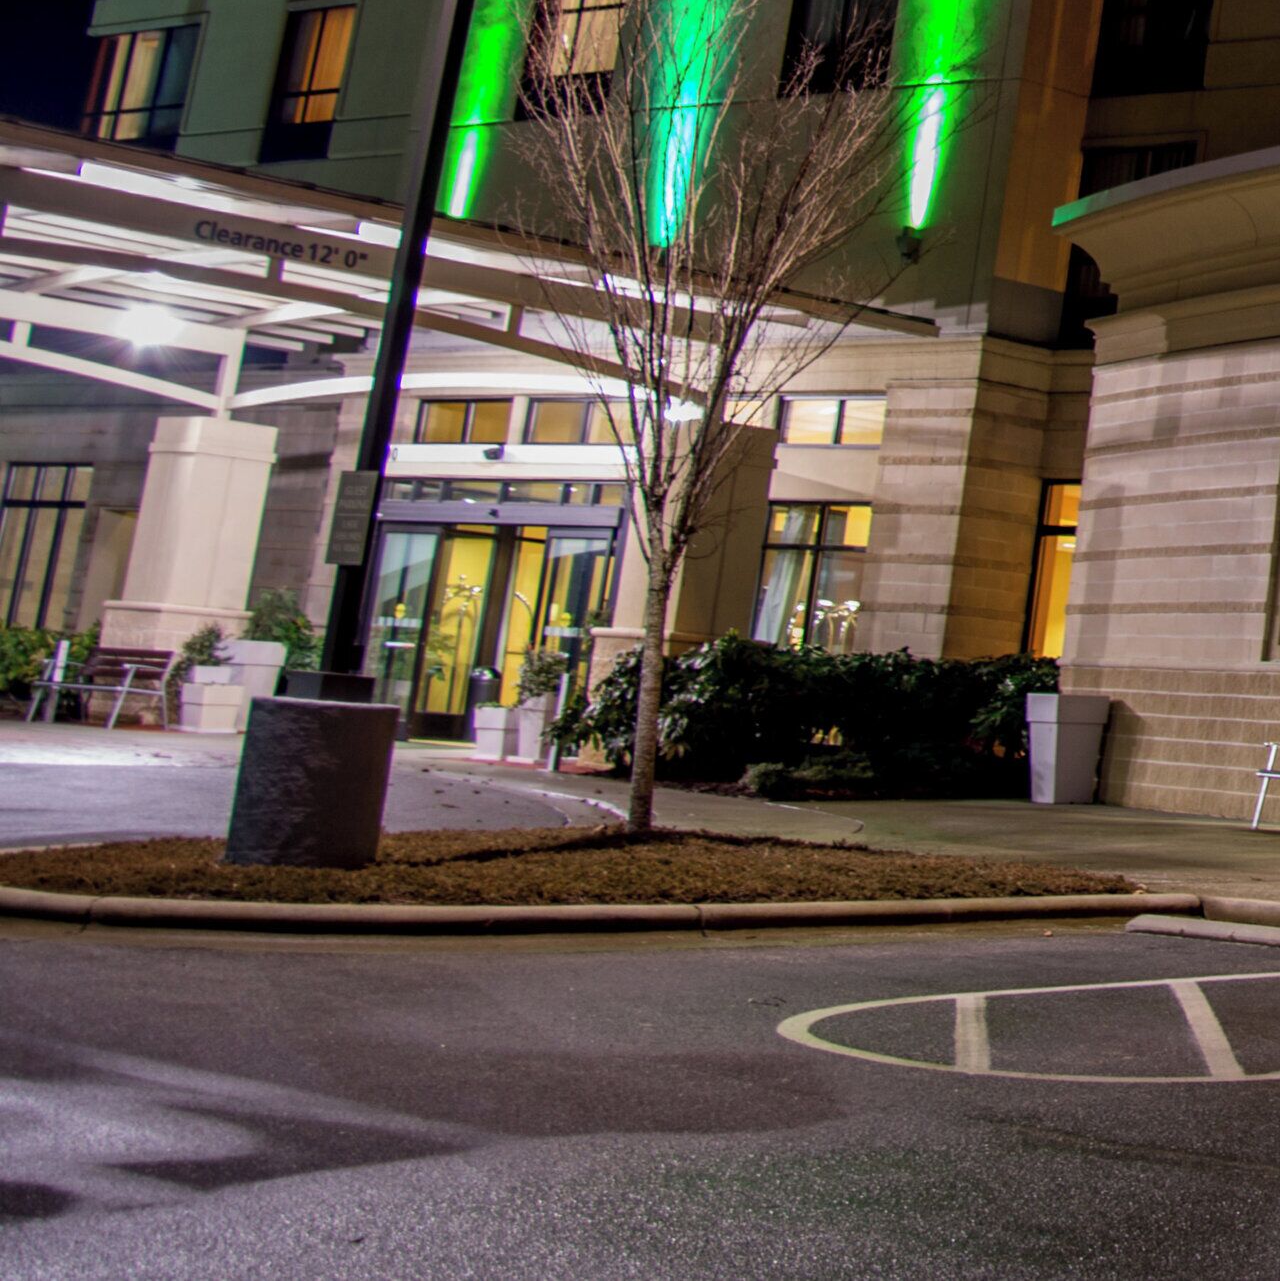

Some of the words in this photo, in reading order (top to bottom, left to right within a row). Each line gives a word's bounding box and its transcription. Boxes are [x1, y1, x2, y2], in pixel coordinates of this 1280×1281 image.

[194, 220, 304, 259] Clearance
[308, 243, 340, 264] 12'
[344, 250, 368, 269] 0"
